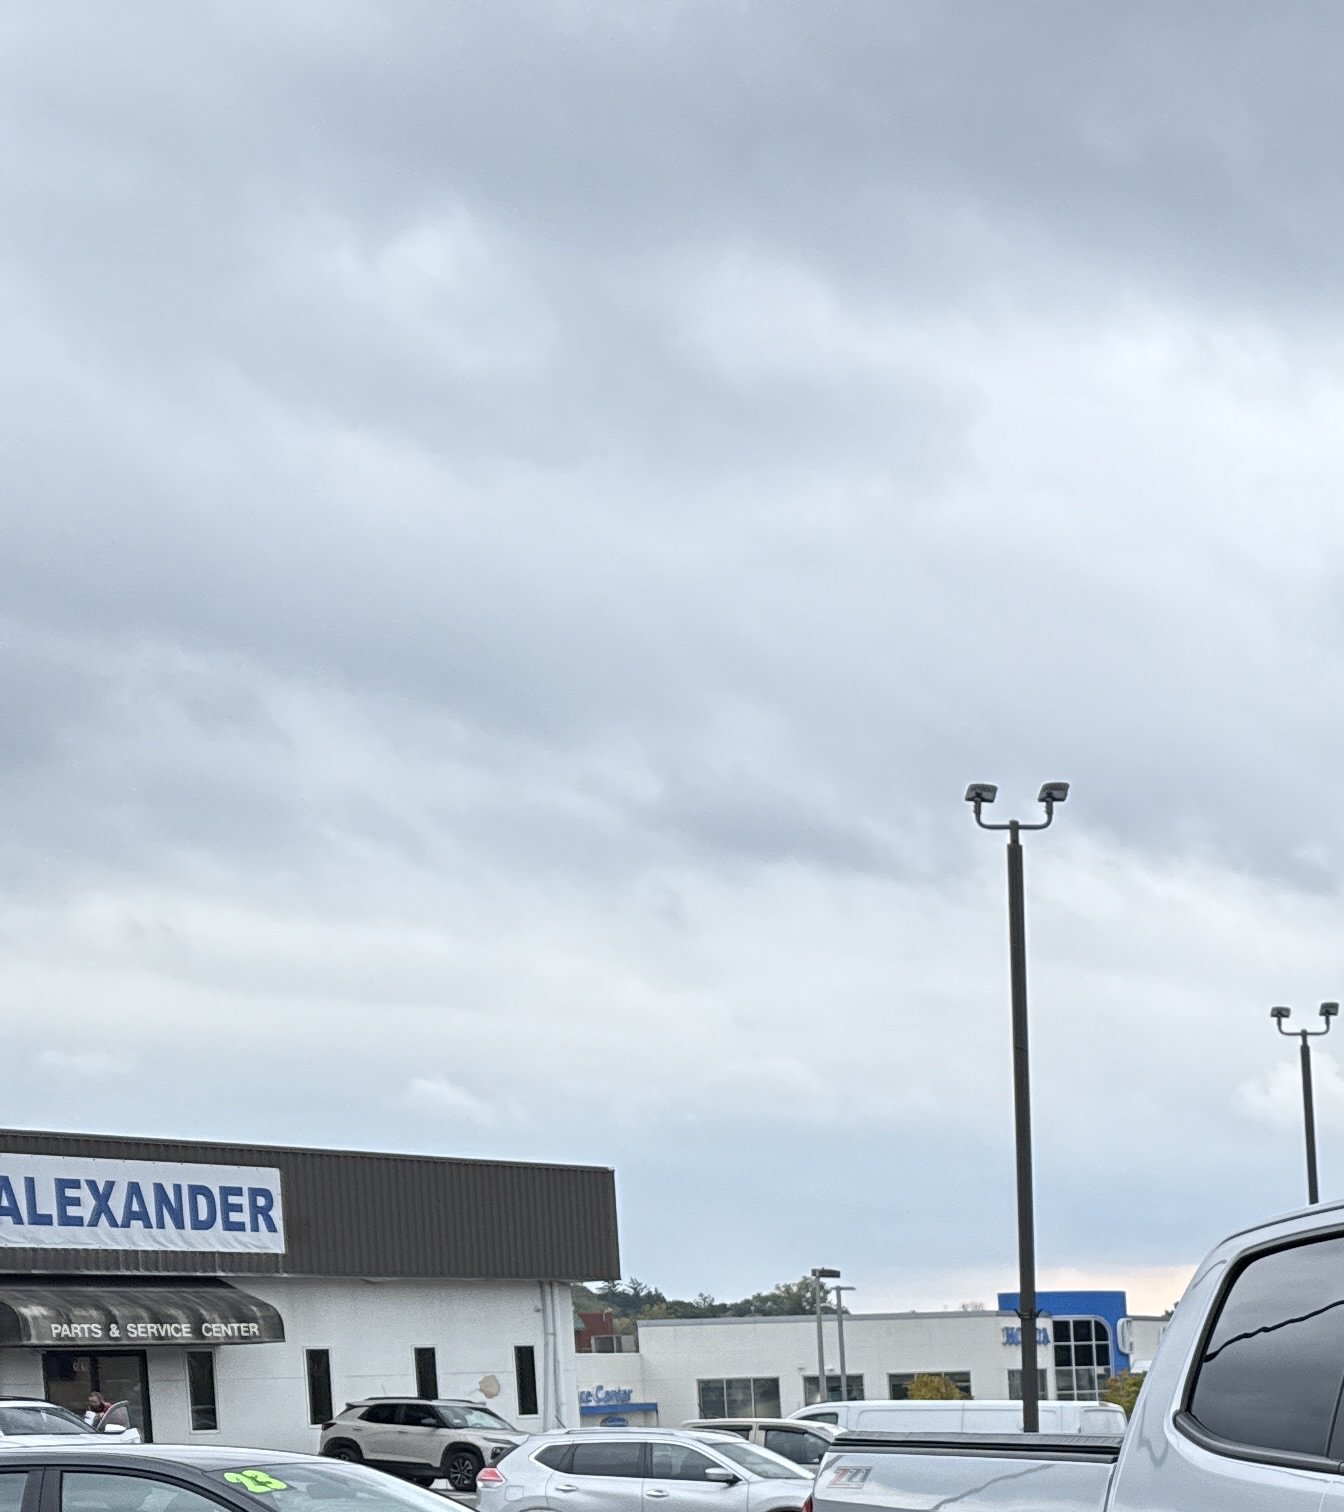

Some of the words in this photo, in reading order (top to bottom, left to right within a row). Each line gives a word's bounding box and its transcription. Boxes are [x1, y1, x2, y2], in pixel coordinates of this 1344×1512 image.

[0, 1175, 279, 1233] ALEXANDER
[51, 1323, 102, 1338] PARTS
[109, 1323, 120, 1337] &
[127, 1323, 192, 1338] SERVICE
[201, 1322, 260, 1337] CENTER
[223, 1469, 288, 1494] 23
